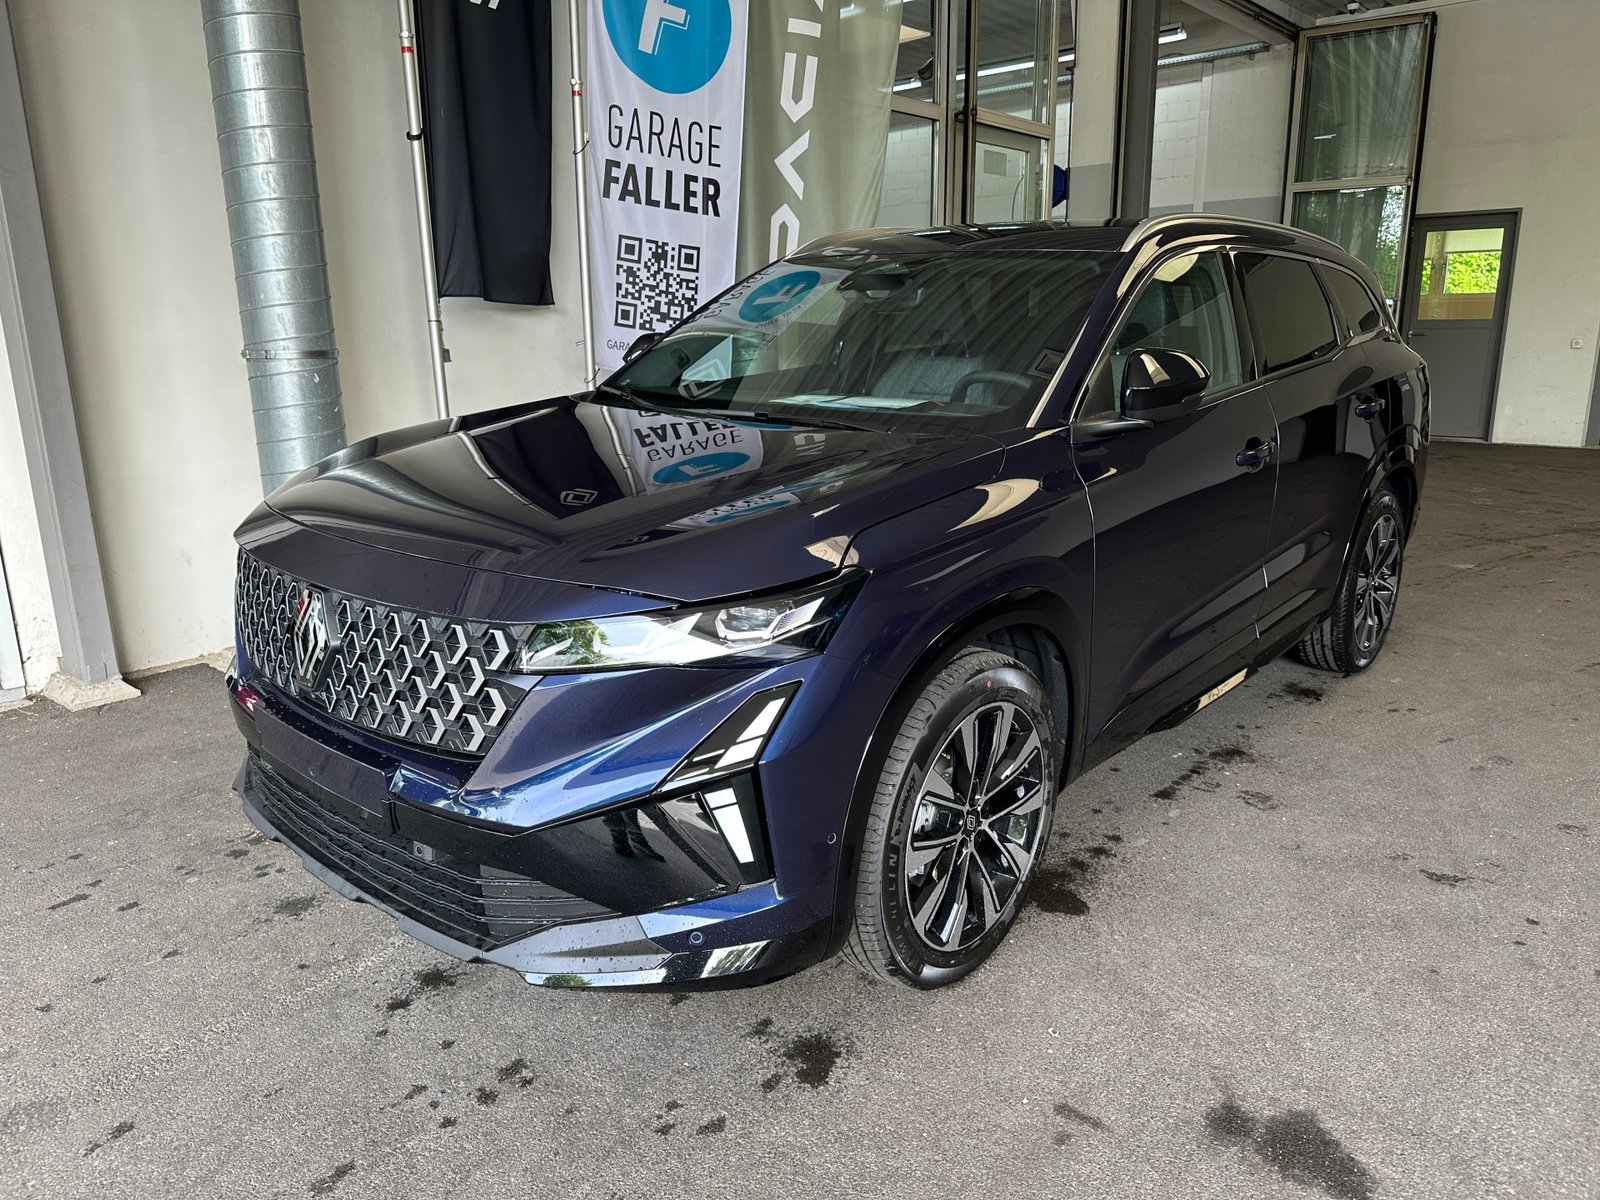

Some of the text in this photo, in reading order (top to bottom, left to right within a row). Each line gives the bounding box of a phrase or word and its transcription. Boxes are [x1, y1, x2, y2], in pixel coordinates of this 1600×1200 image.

[607, 104, 722, 168] GARAGE
[769, 0, 824, 264] DACI
[601, 159, 722, 218] FALLER
[606, 339, 631, 352] GARA
